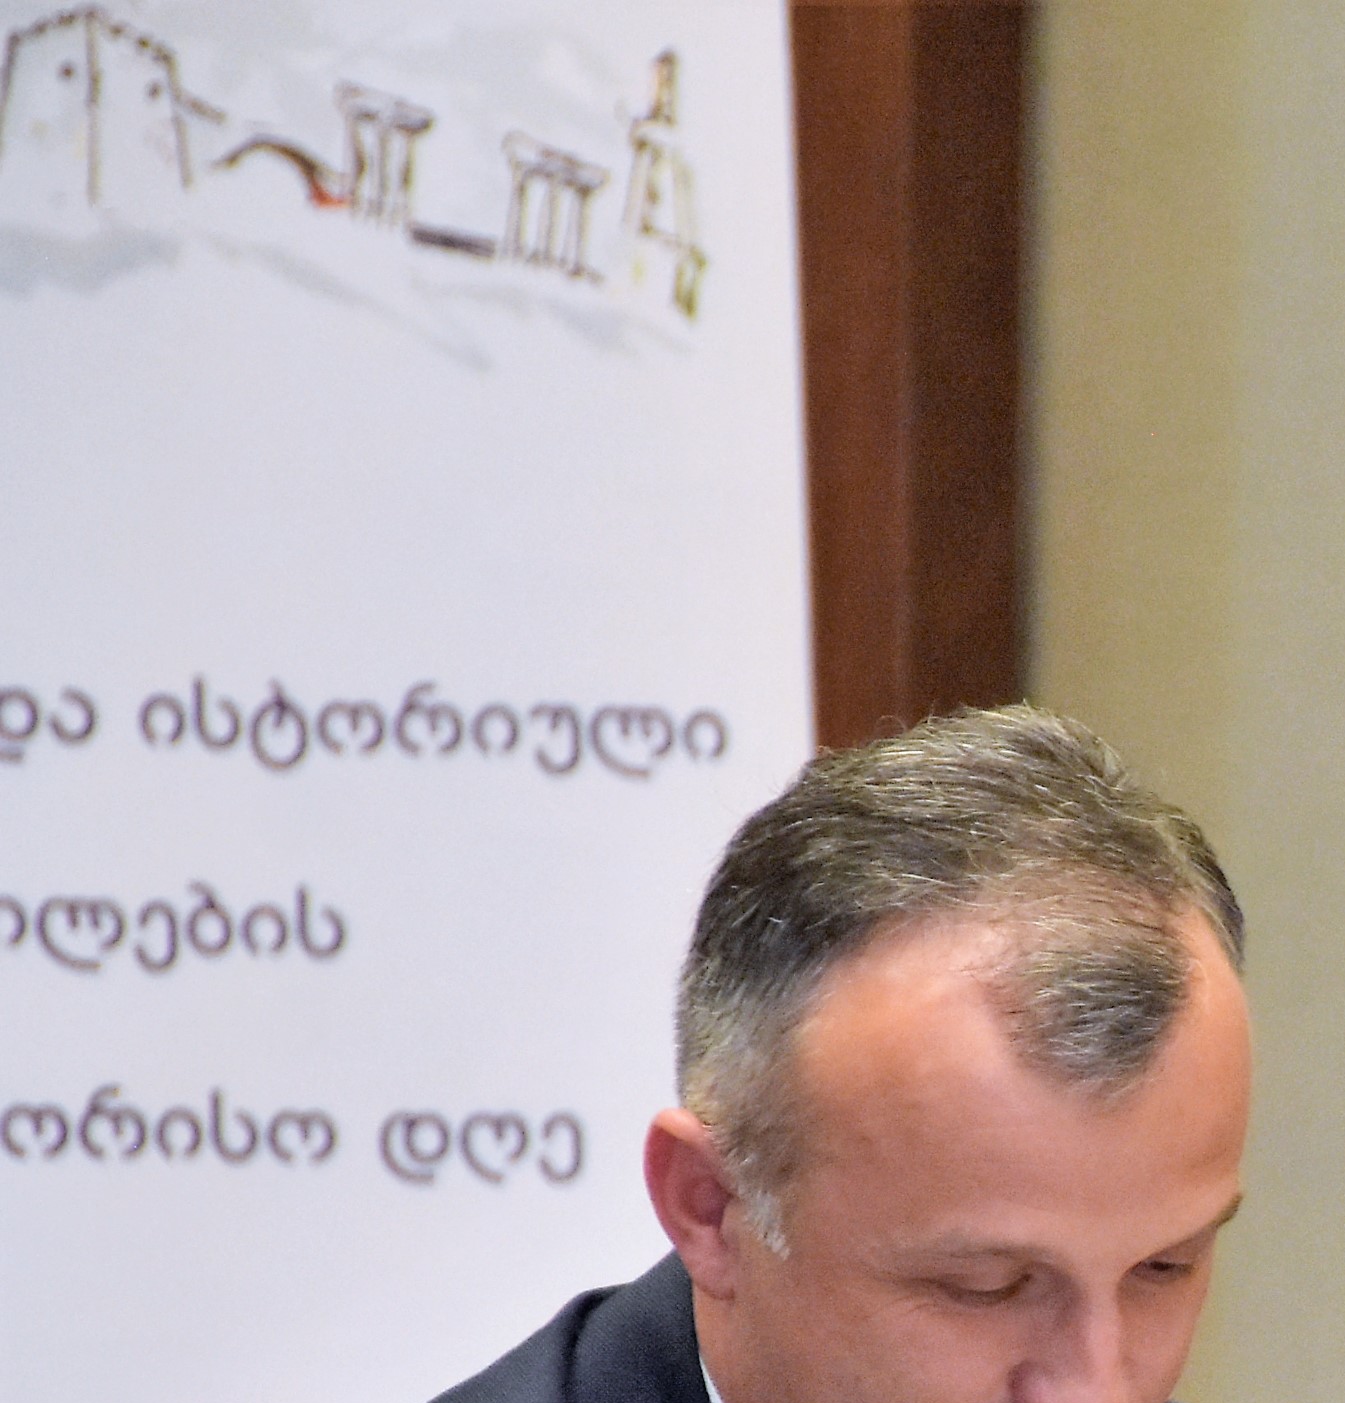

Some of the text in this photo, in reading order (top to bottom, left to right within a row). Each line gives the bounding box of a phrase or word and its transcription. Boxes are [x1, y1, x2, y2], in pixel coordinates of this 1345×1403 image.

[138, 675, 728, 780] ისტორიული
[0, 1084, 584, 1186] ორისო დღე
